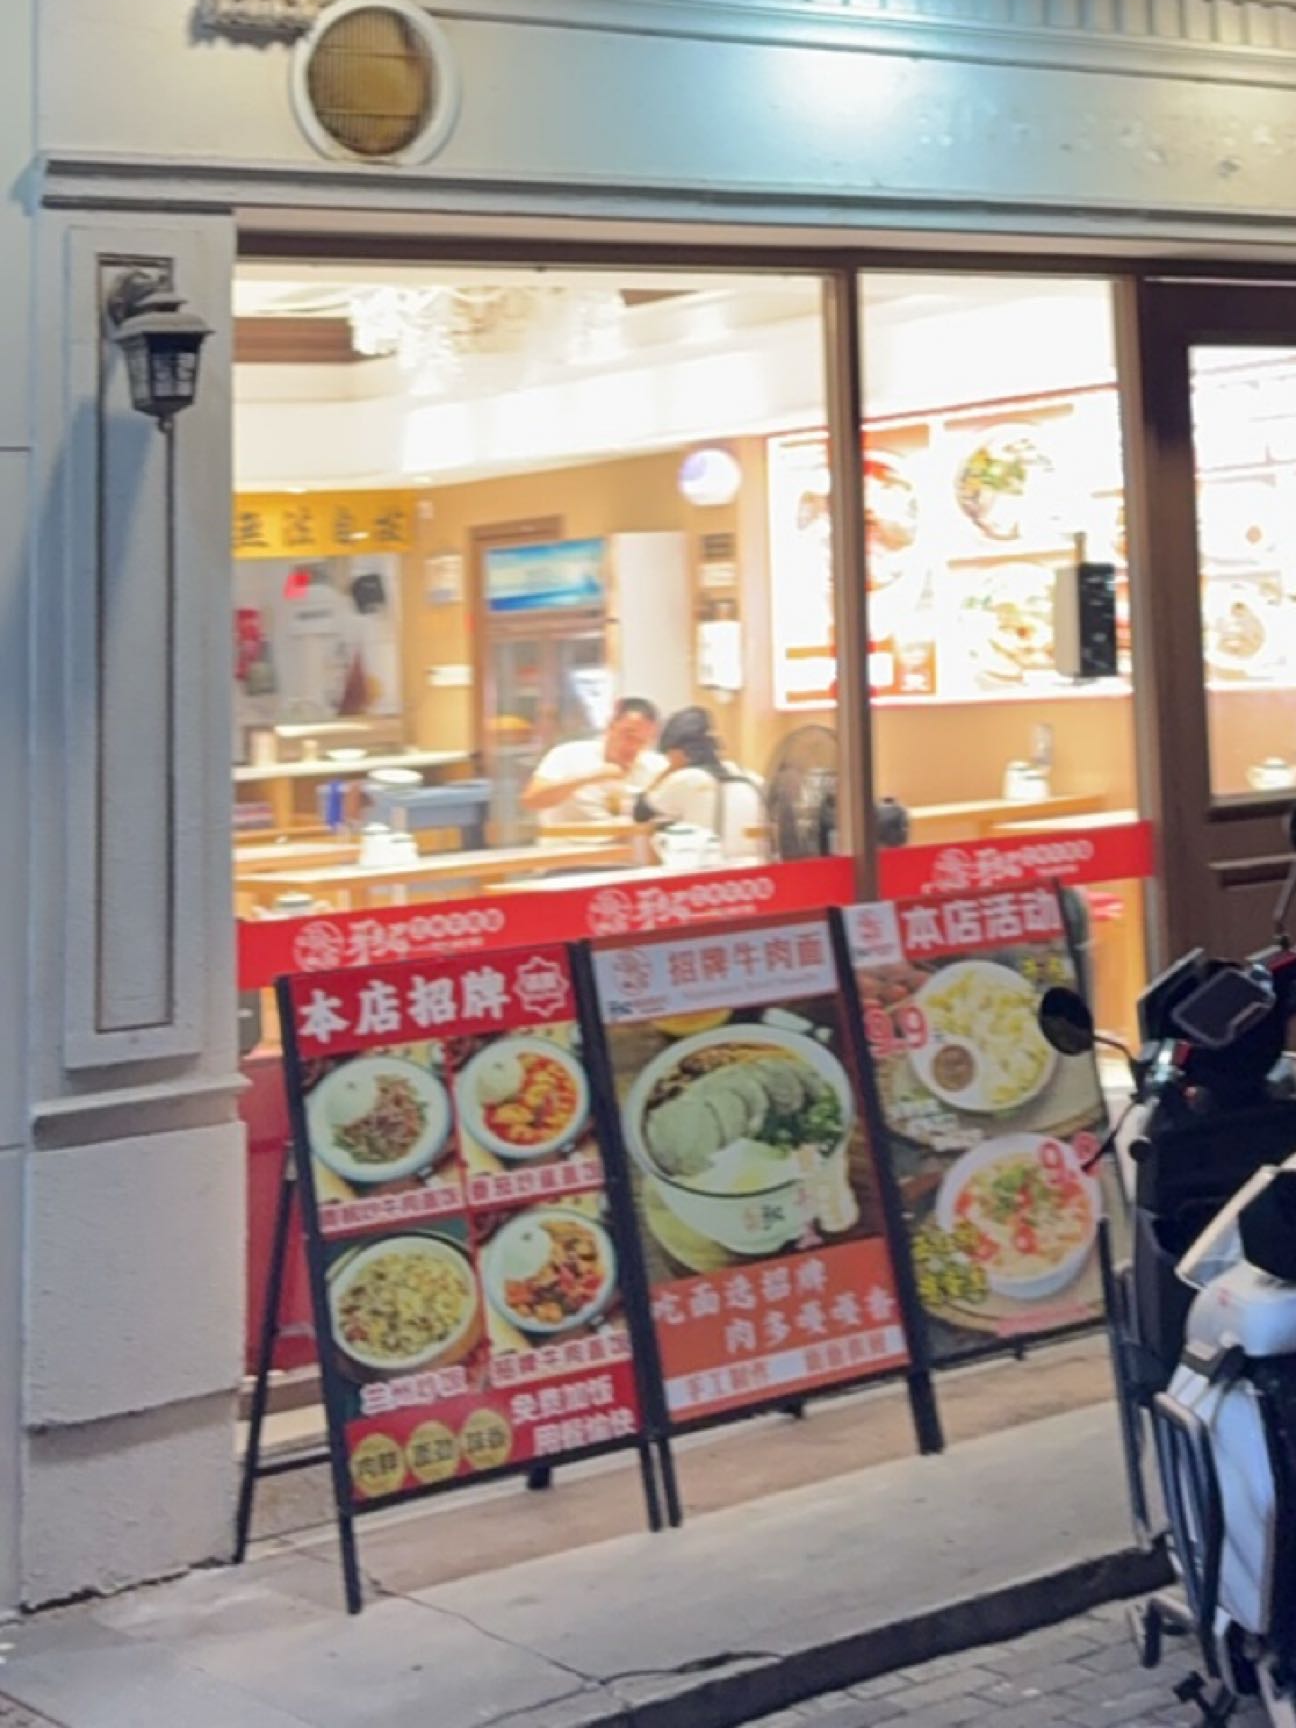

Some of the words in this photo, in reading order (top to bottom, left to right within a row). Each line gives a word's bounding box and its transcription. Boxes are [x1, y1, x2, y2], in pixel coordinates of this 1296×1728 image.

[902, 887, 1062, 951] 本店活动
[668, 932, 823, 987] 招牌牛肉面
[298, 965, 510, 1043] 本店招牌
